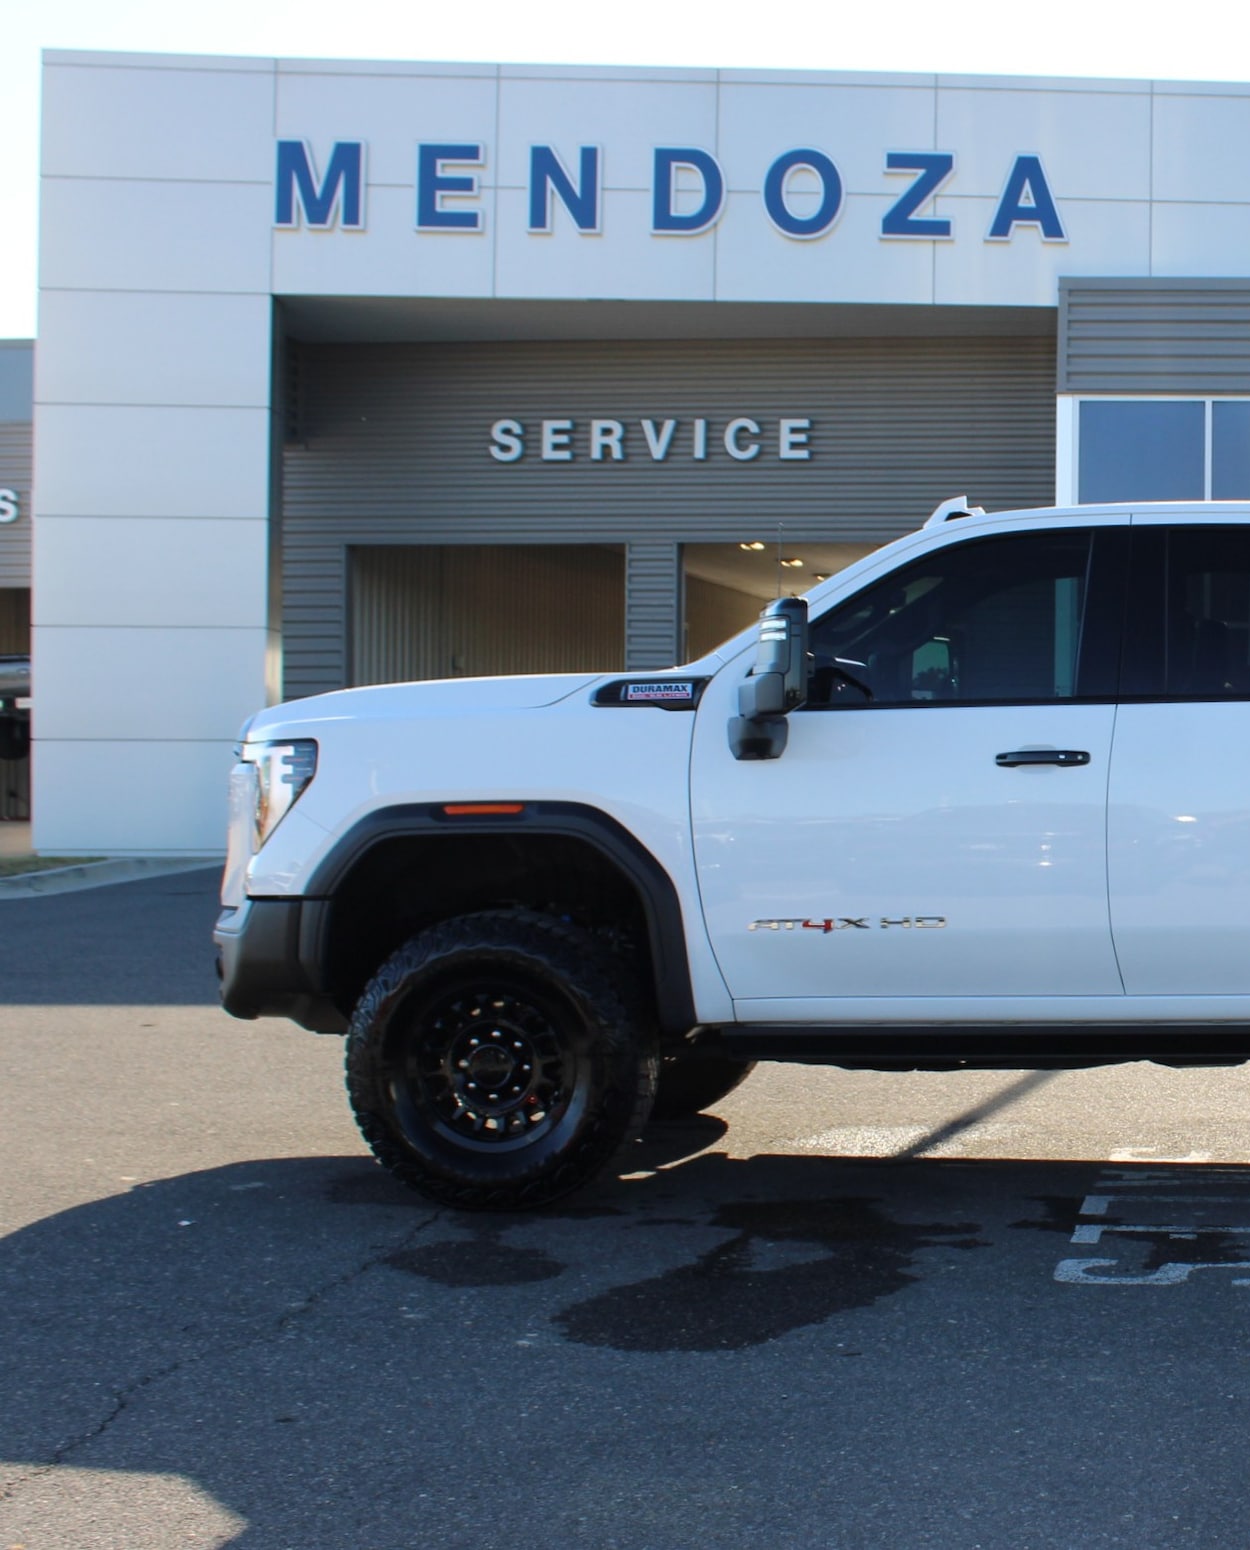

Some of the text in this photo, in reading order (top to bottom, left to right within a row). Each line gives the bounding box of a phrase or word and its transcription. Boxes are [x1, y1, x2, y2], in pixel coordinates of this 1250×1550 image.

[273, 140, 1068, 242] MENDOZA
[489, 418, 811, 461] SERVICE
[632, 684, 688, 693] DURAMAX
[880, 916, 946, 929] HD
